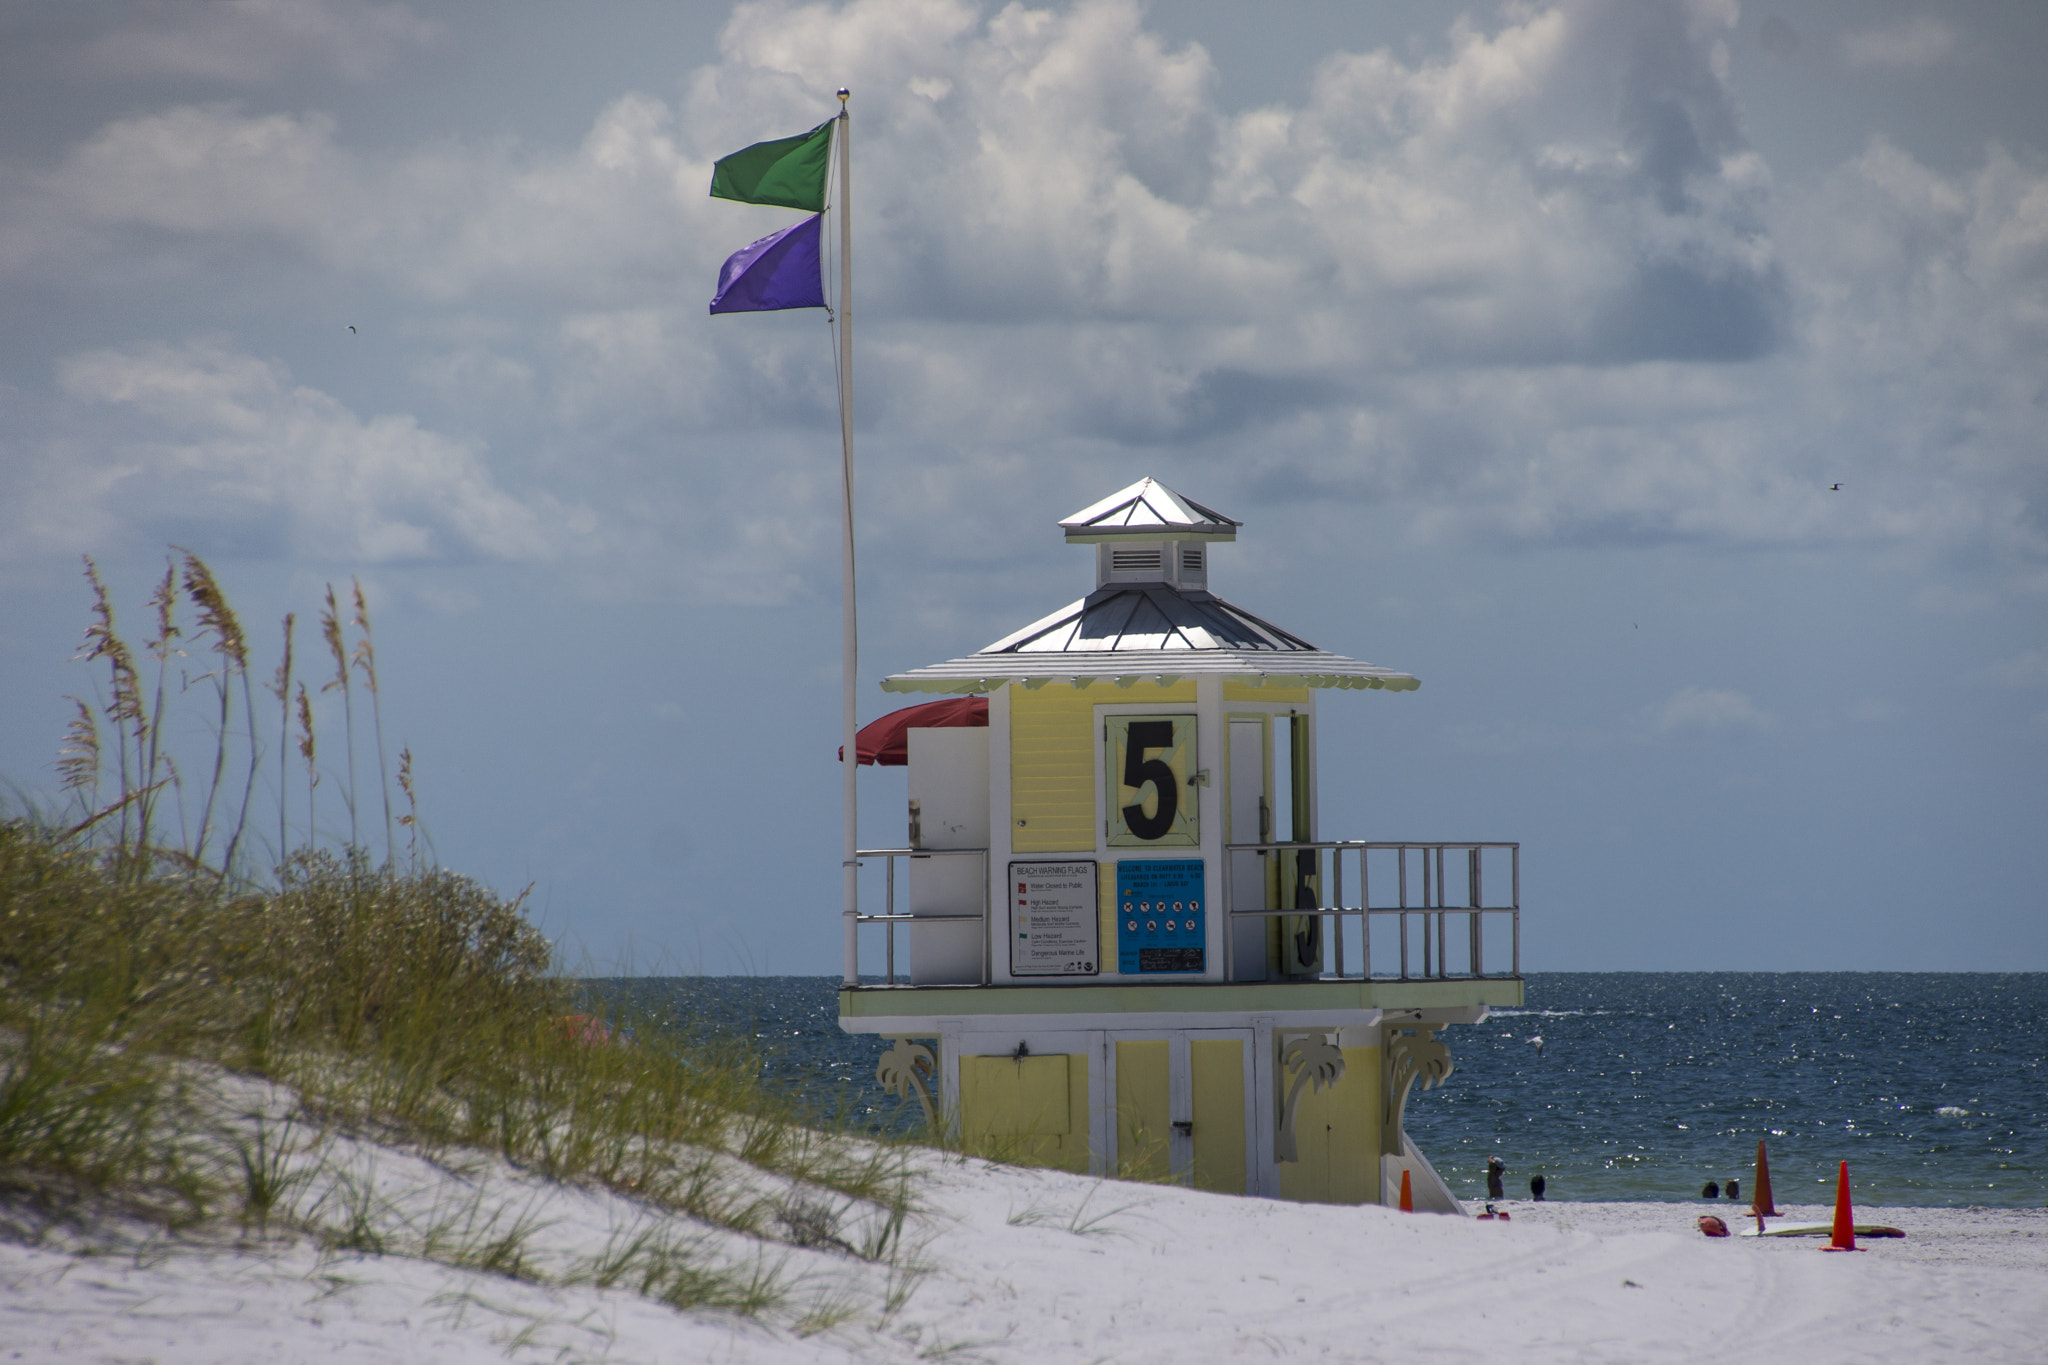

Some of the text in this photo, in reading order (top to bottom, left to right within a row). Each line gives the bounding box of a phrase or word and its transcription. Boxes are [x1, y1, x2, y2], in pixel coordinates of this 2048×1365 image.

[1122, 720, 1178, 840] 5
[1017, 866, 1088, 875] BEACH WARNING FLAGS
[1153, 864, 1185, 872] CLEARWATER
[1030, 899, 1040, 907] High
